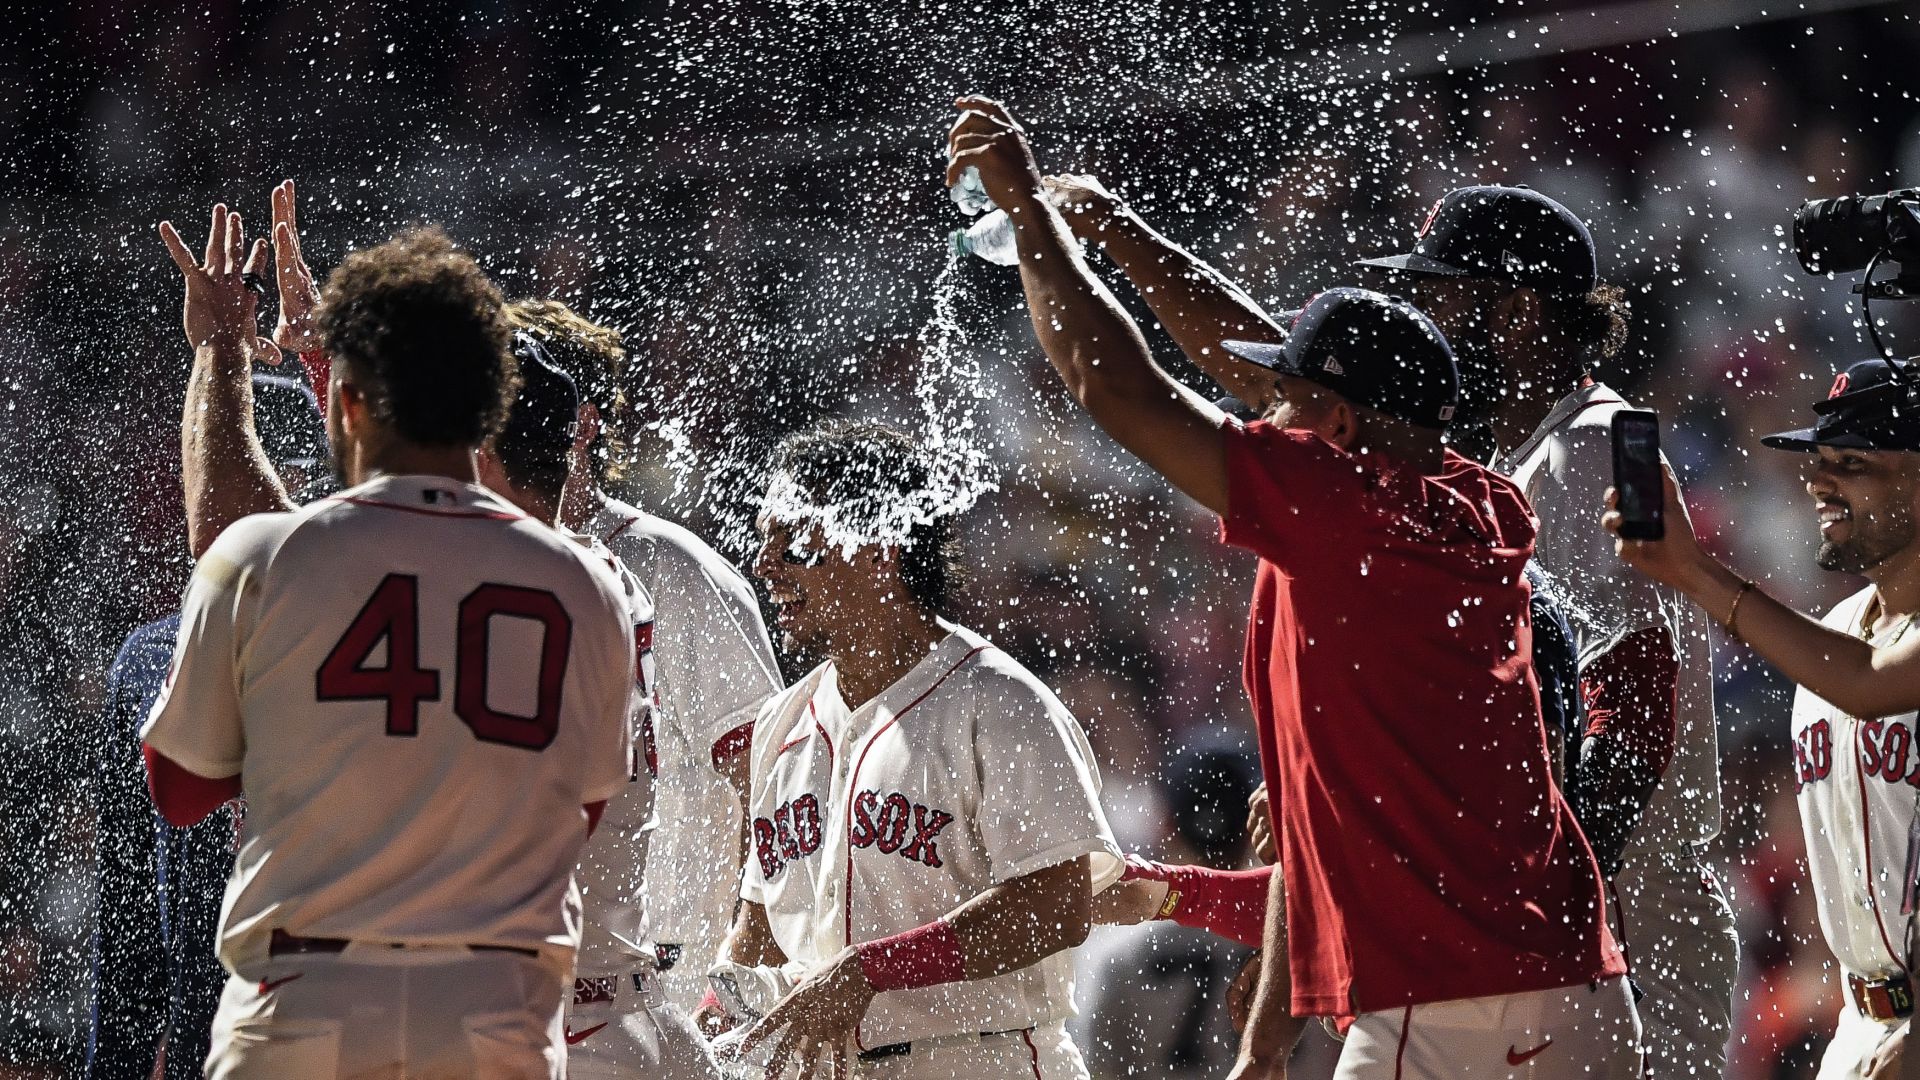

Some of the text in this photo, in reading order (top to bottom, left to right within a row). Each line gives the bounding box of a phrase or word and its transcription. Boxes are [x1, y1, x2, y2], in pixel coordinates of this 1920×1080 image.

[316, 572, 573, 752] 40
[1792, 718, 1920, 794] ED SO
[753, 788, 954, 880] RED SOX
[1888, 986, 1910, 1009] 75
